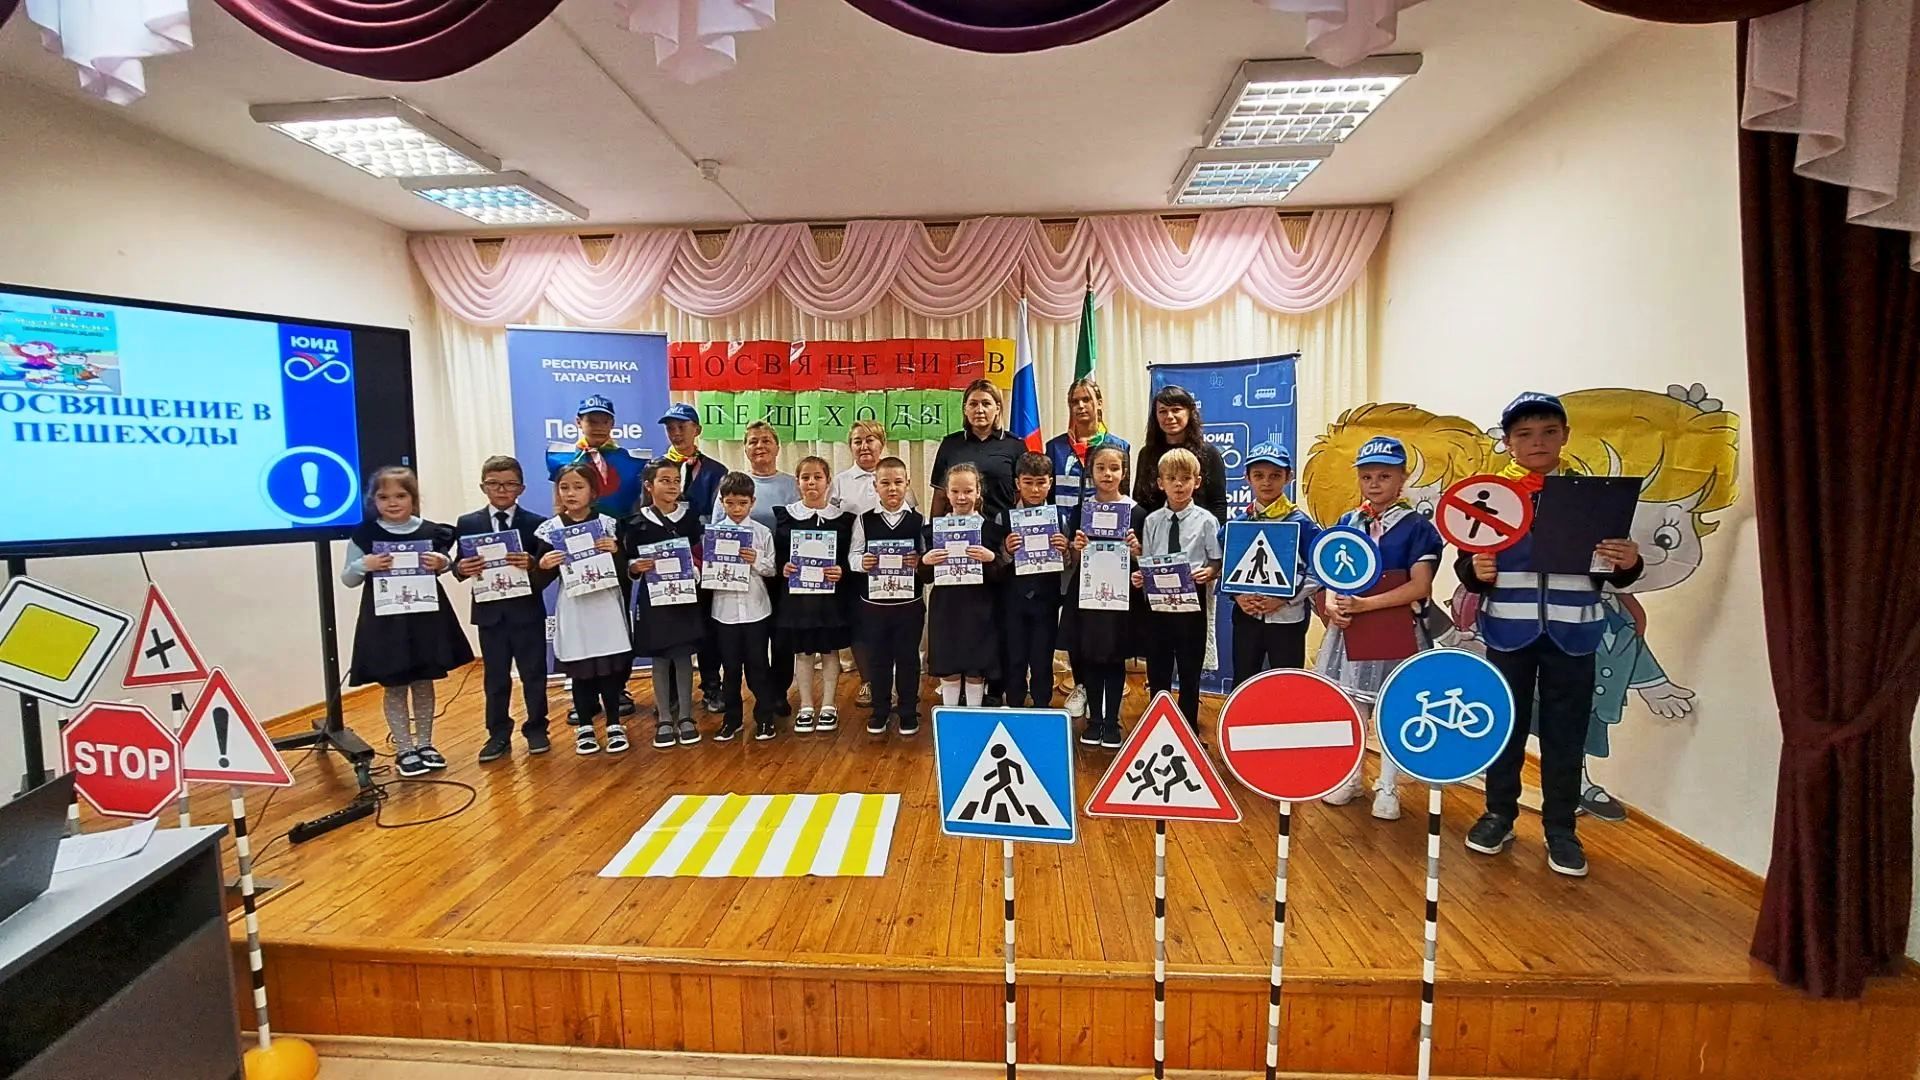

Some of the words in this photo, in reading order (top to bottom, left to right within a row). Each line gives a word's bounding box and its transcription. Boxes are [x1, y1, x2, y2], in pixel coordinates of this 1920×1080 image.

[290, 335, 339, 353] ЮИД
[541, 358, 639, 371] РЕСПУБЛИКА
[671, 352, 974, 383] ПОСВЯЩЕНИЕ
[987, 351, 1005, 373] В
[552, 372, 632, 384] ТАТАРСТАН
[253, 403, 272, 421] В
[704, 403, 943, 430] ПЕШЕХОДЫ
[14, 422, 238, 448] ПЕШЕХОДЫ
[545, 419, 643, 439] Пеые
[1360, 442, 1392, 457] ЮИД
[74, 741, 170, 780] STOP
